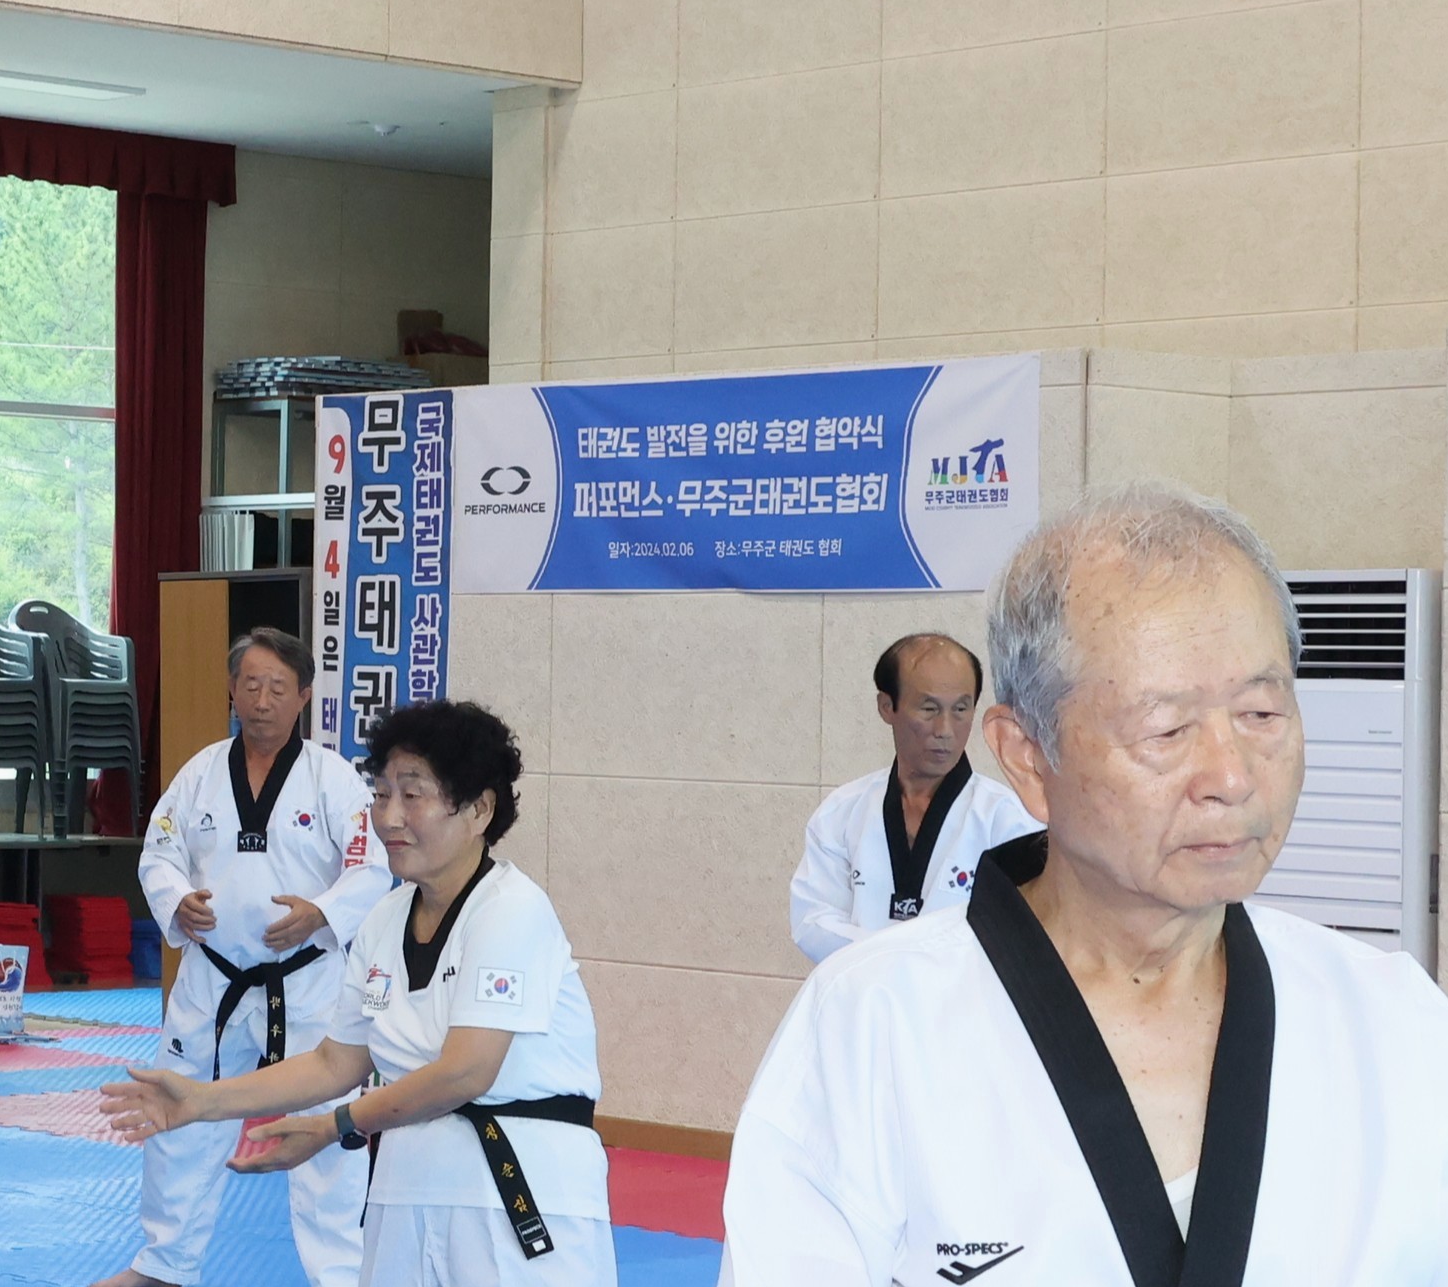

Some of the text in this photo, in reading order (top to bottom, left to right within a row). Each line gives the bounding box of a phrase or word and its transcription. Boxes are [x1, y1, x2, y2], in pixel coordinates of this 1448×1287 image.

[577, 414, 884, 459] 태권도 발전을 위한 후원 협약식
[412, 402, 444, 587] 국제태권도
[925, 488, 1009, 505] 무주군태권도협회
[464, 502, 546, 515] PERFORMANCE
[608, 538, 842, 559] 일자:2024.02.06 장소:무주군 태권도 협회
[894, 898, 918, 915] KTA
[936, 1241, 1004, 1256] PRO-SPECS
